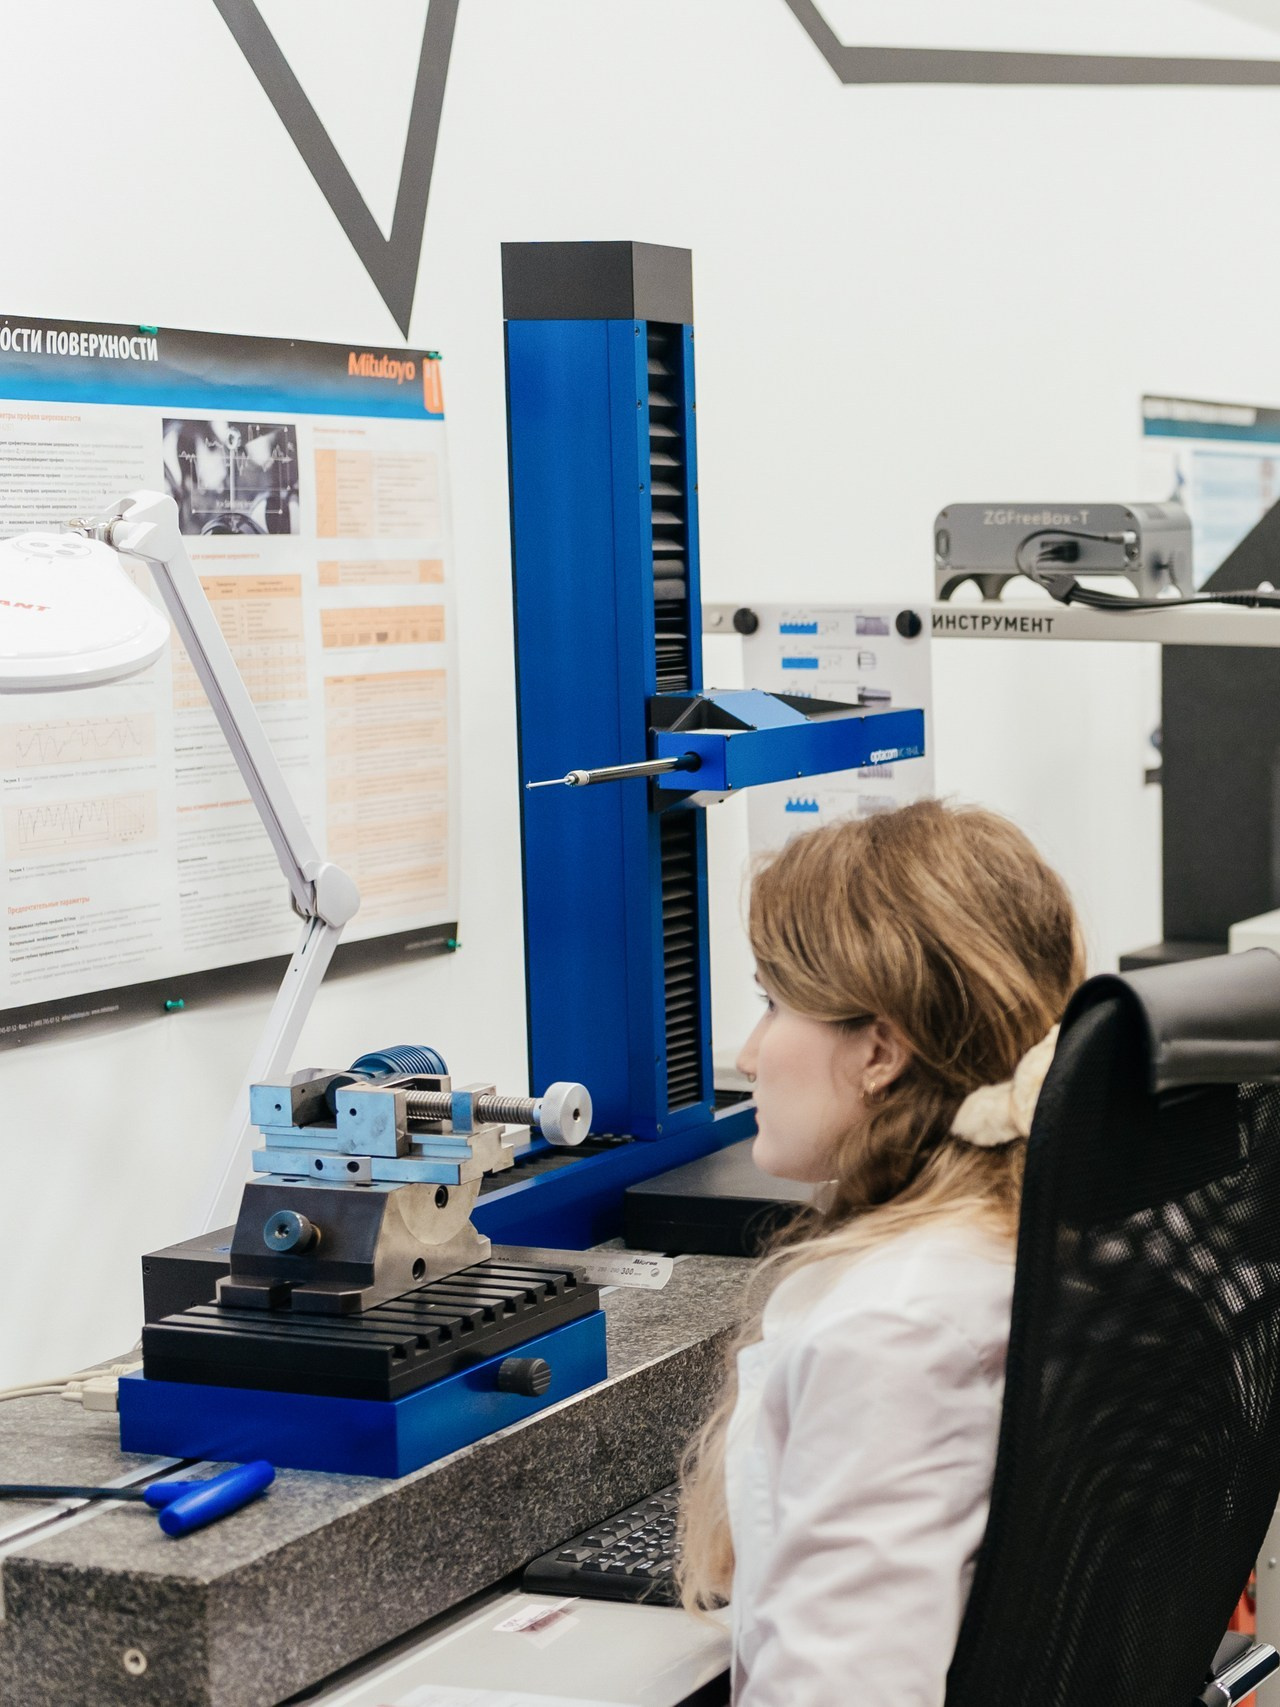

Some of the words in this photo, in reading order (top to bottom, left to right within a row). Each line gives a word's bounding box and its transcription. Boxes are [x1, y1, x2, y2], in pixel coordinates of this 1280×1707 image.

[0, 326, 42, 354] ОСТИ
[46, 330, 159, 361] ПОВЕРХНОСТИ
[347, 351, 416, 385] Mitutoyo
[983, 509, 1089, 525] ZGFreeBox-T
[932, 613, 1055, 633] ИНСТРУМЕНТ
[620, 1267, 634, 1275] 300
